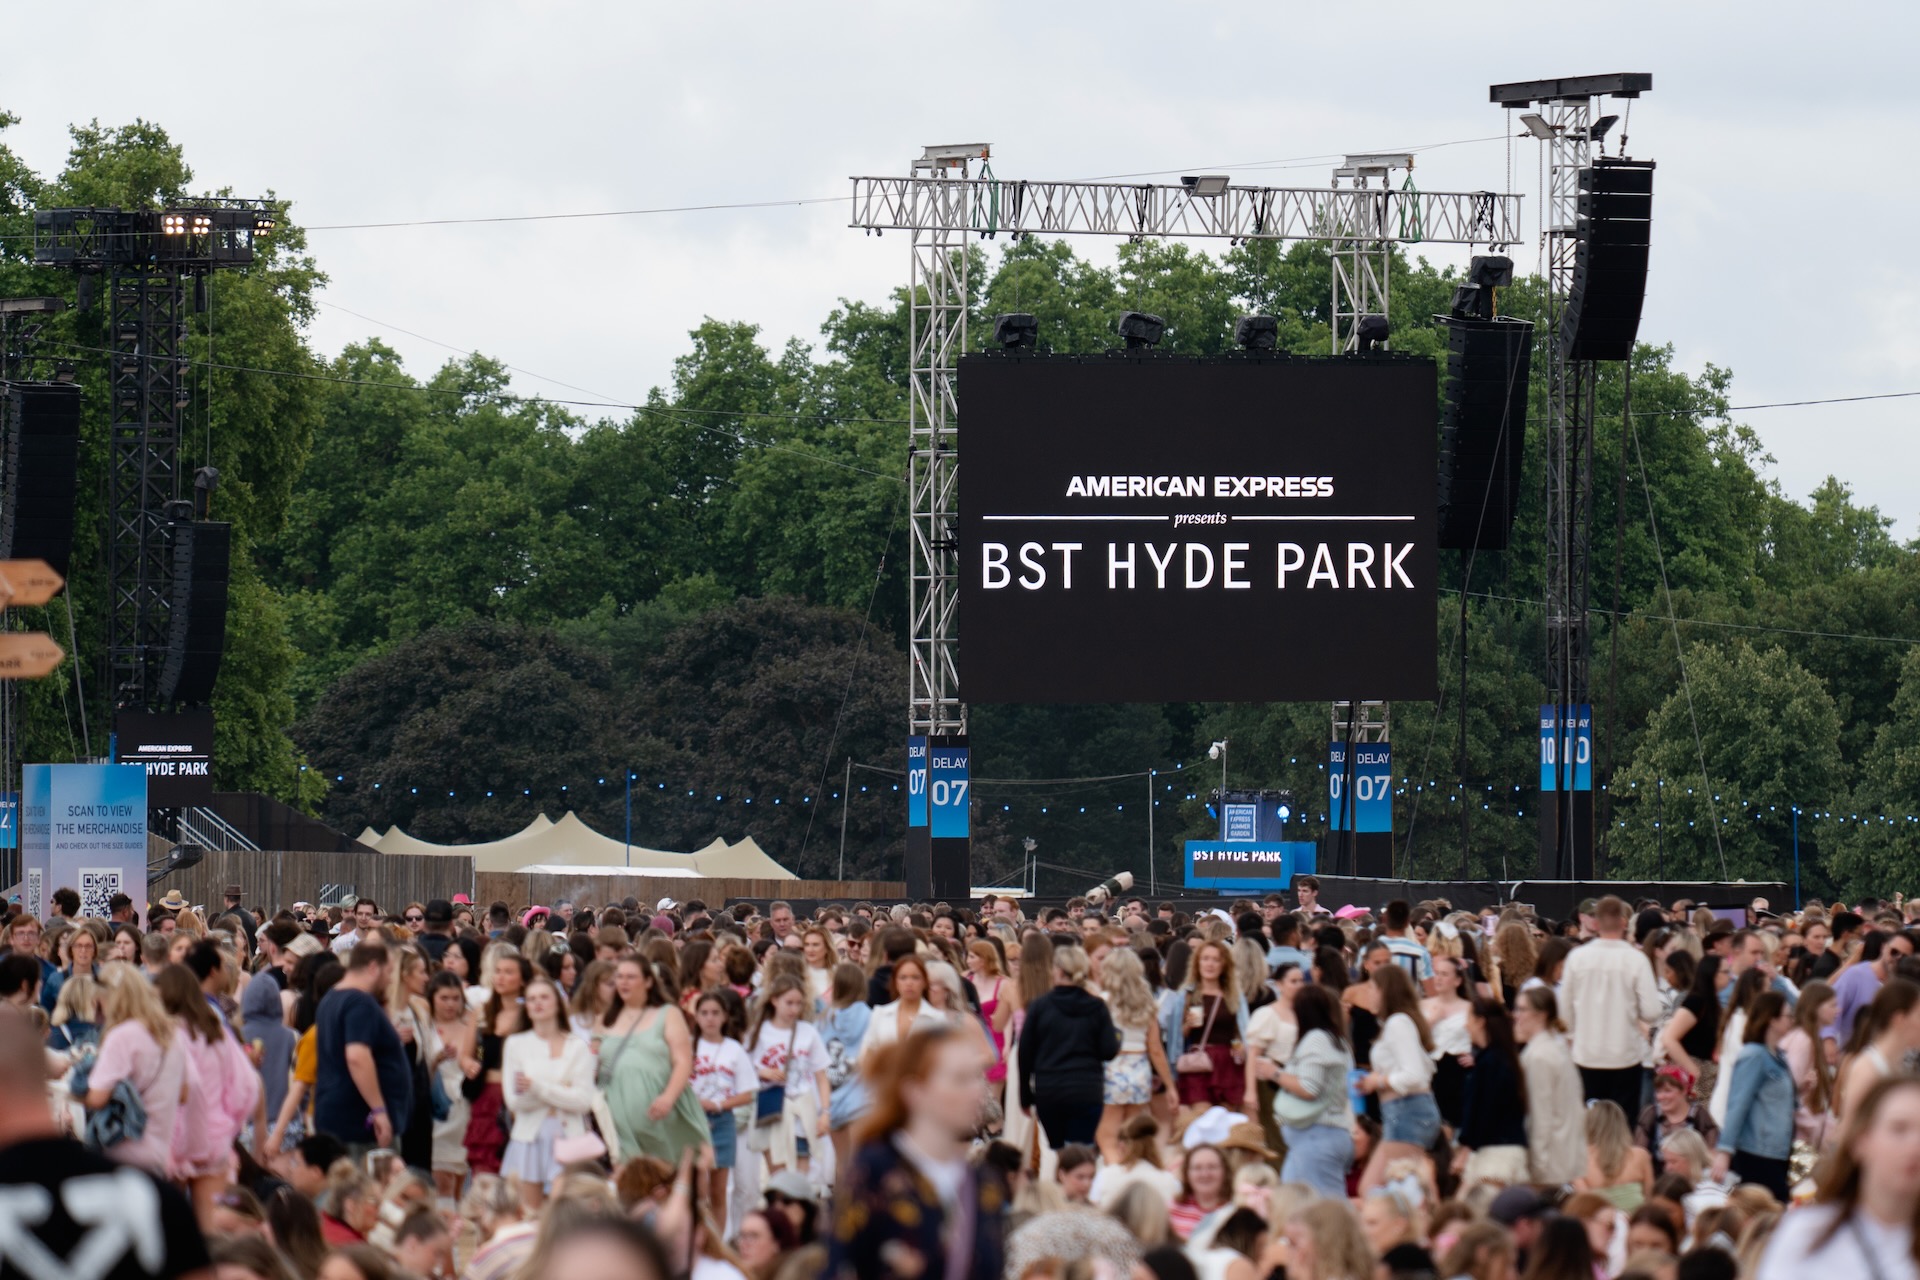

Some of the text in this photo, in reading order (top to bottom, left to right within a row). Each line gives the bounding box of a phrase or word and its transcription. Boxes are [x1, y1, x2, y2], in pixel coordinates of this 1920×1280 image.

[1066, 475, 1334, 497] AMERICAN EXPRESS
[1173, 512, 1227, 528] presents
[982, 541, 1415, 590] BST HYDE PARK
[909, 746, 926, 757] DELAY
[1541, 736, 1556, 764] 10
[932, 757, 967, 769] DELAY
[1357, 753, 1390, 764] DELAY
[146, 762, 209, 775] HYDE PARK
[909, 769, 927, 795] 07
[1356, 775, 1391, 800] 07
[932, 780, 969, 806] 07
[68, 805, 133, 817] SCAN TO VIEW
[56, 823, 75, 835] THE
[78, 823, 143, 835] MERCHANDISE
[56, 842, 69, 850] AND
[69, 842, 88, 850] CHECK
[89, 842, 100, 850] OUT
[101, 842, 112, 850] THE
[112, 842, 124, 850] SIZE
[125, 842, 143, 850] GUIDES
[1218, 850, 1249, 862] HYDE
[1252, 850, 1282, 862] PARK
